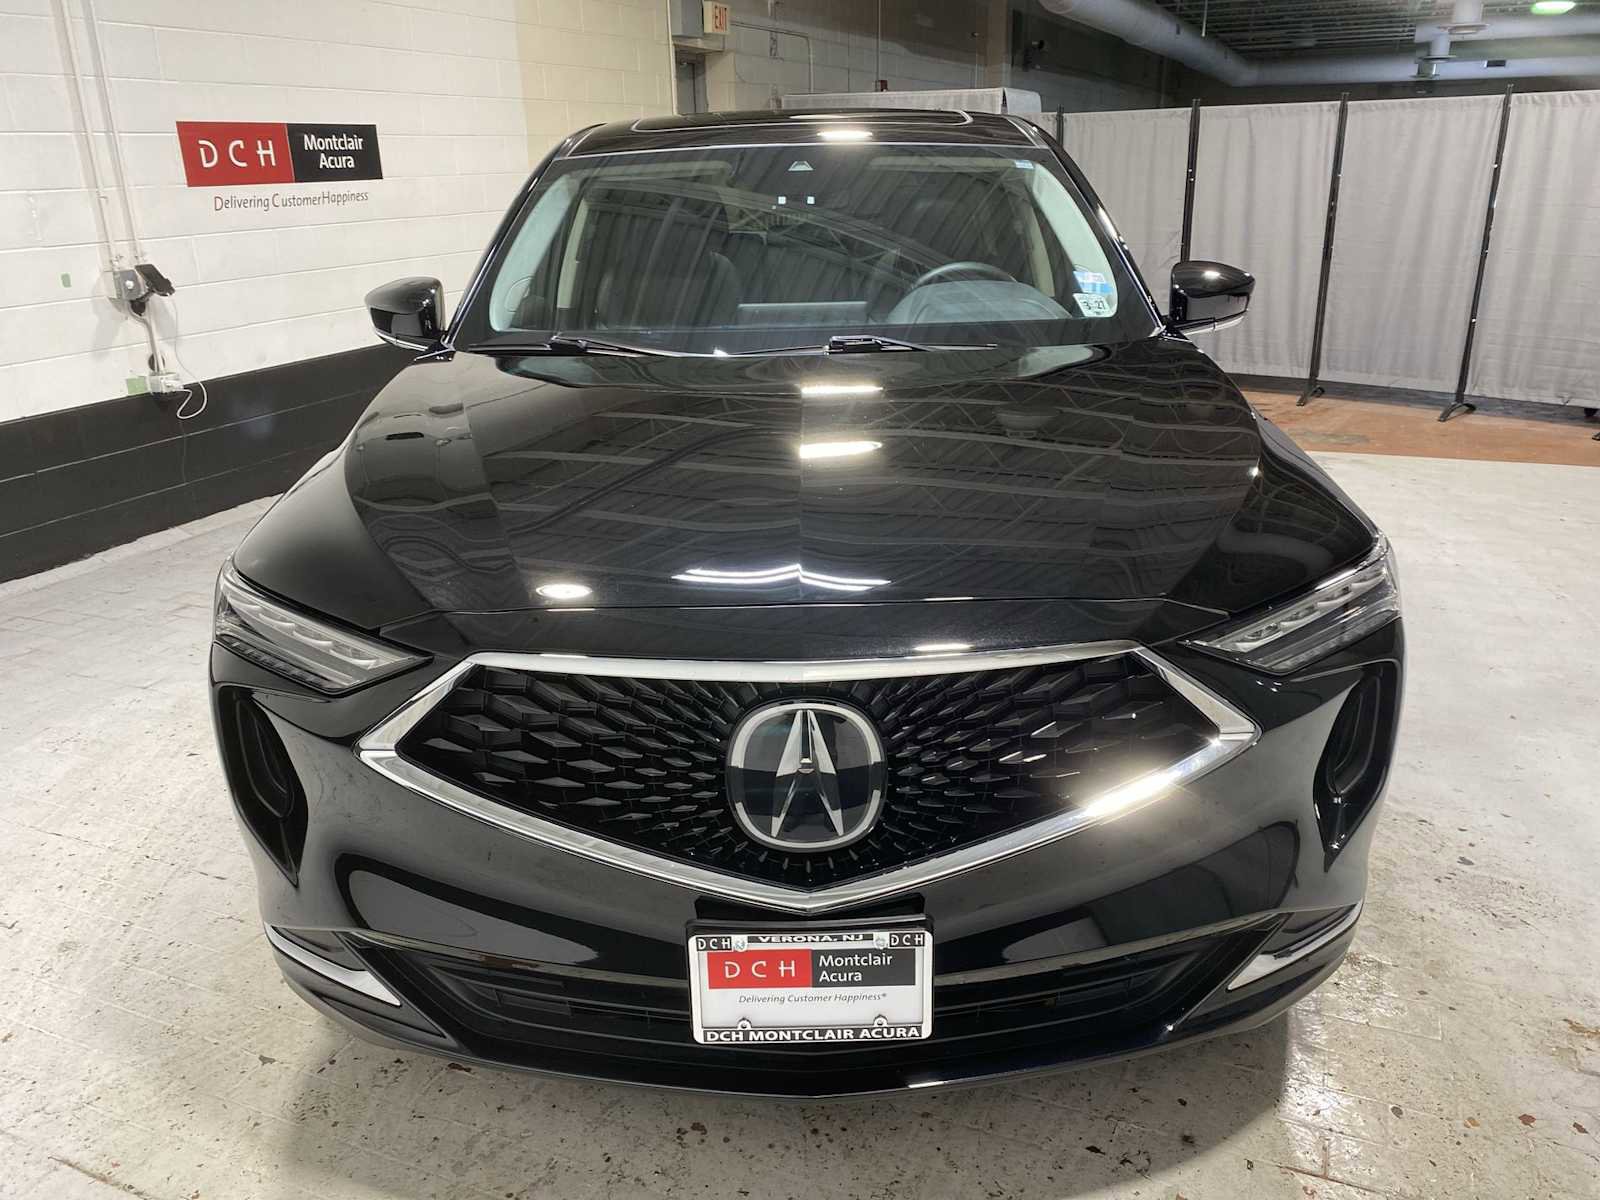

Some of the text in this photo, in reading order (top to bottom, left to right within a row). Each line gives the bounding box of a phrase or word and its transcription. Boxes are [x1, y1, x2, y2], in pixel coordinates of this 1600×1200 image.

[714, 5, 728, 32] EXIT
[303, 133, 364, 151] Montclair
[319, 152, 355, 169] Acura
[213, 189, 369, 212] Delivering Customer Happiness
[842, 934, 864, 942] NJ
[818, 952, 893, 968] Montclair
[818, 970, 863, 983] Acura
[738, 994, 786, 1005] Delivering
[787, 993, 832, 1003] Customer
[706, 1026, 921, 1042] DCH MONTCLAIR ACURA
